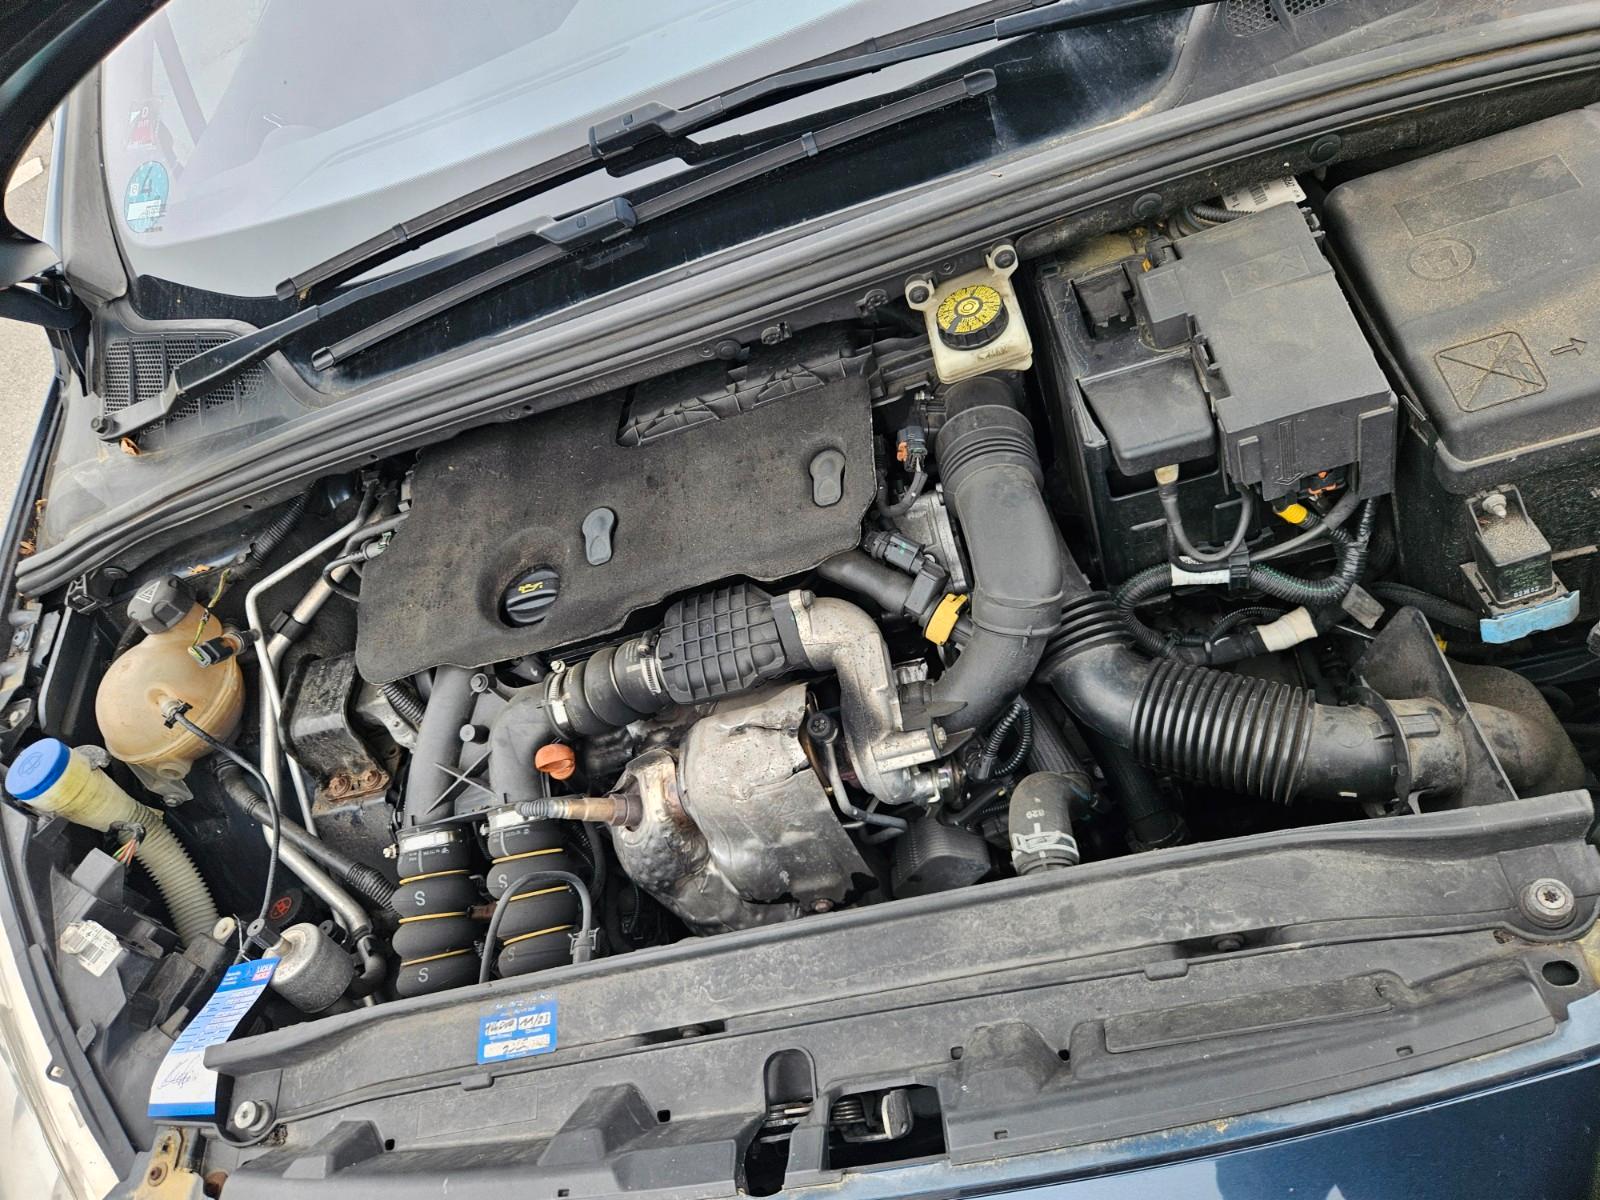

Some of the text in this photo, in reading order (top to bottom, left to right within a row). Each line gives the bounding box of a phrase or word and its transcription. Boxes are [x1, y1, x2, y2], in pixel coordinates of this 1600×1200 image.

[498, 874, 508, 888] S
[414, 890, 426, 906] S
[507, 946, 515, 961] S
[418, 967, 429, 983] S
